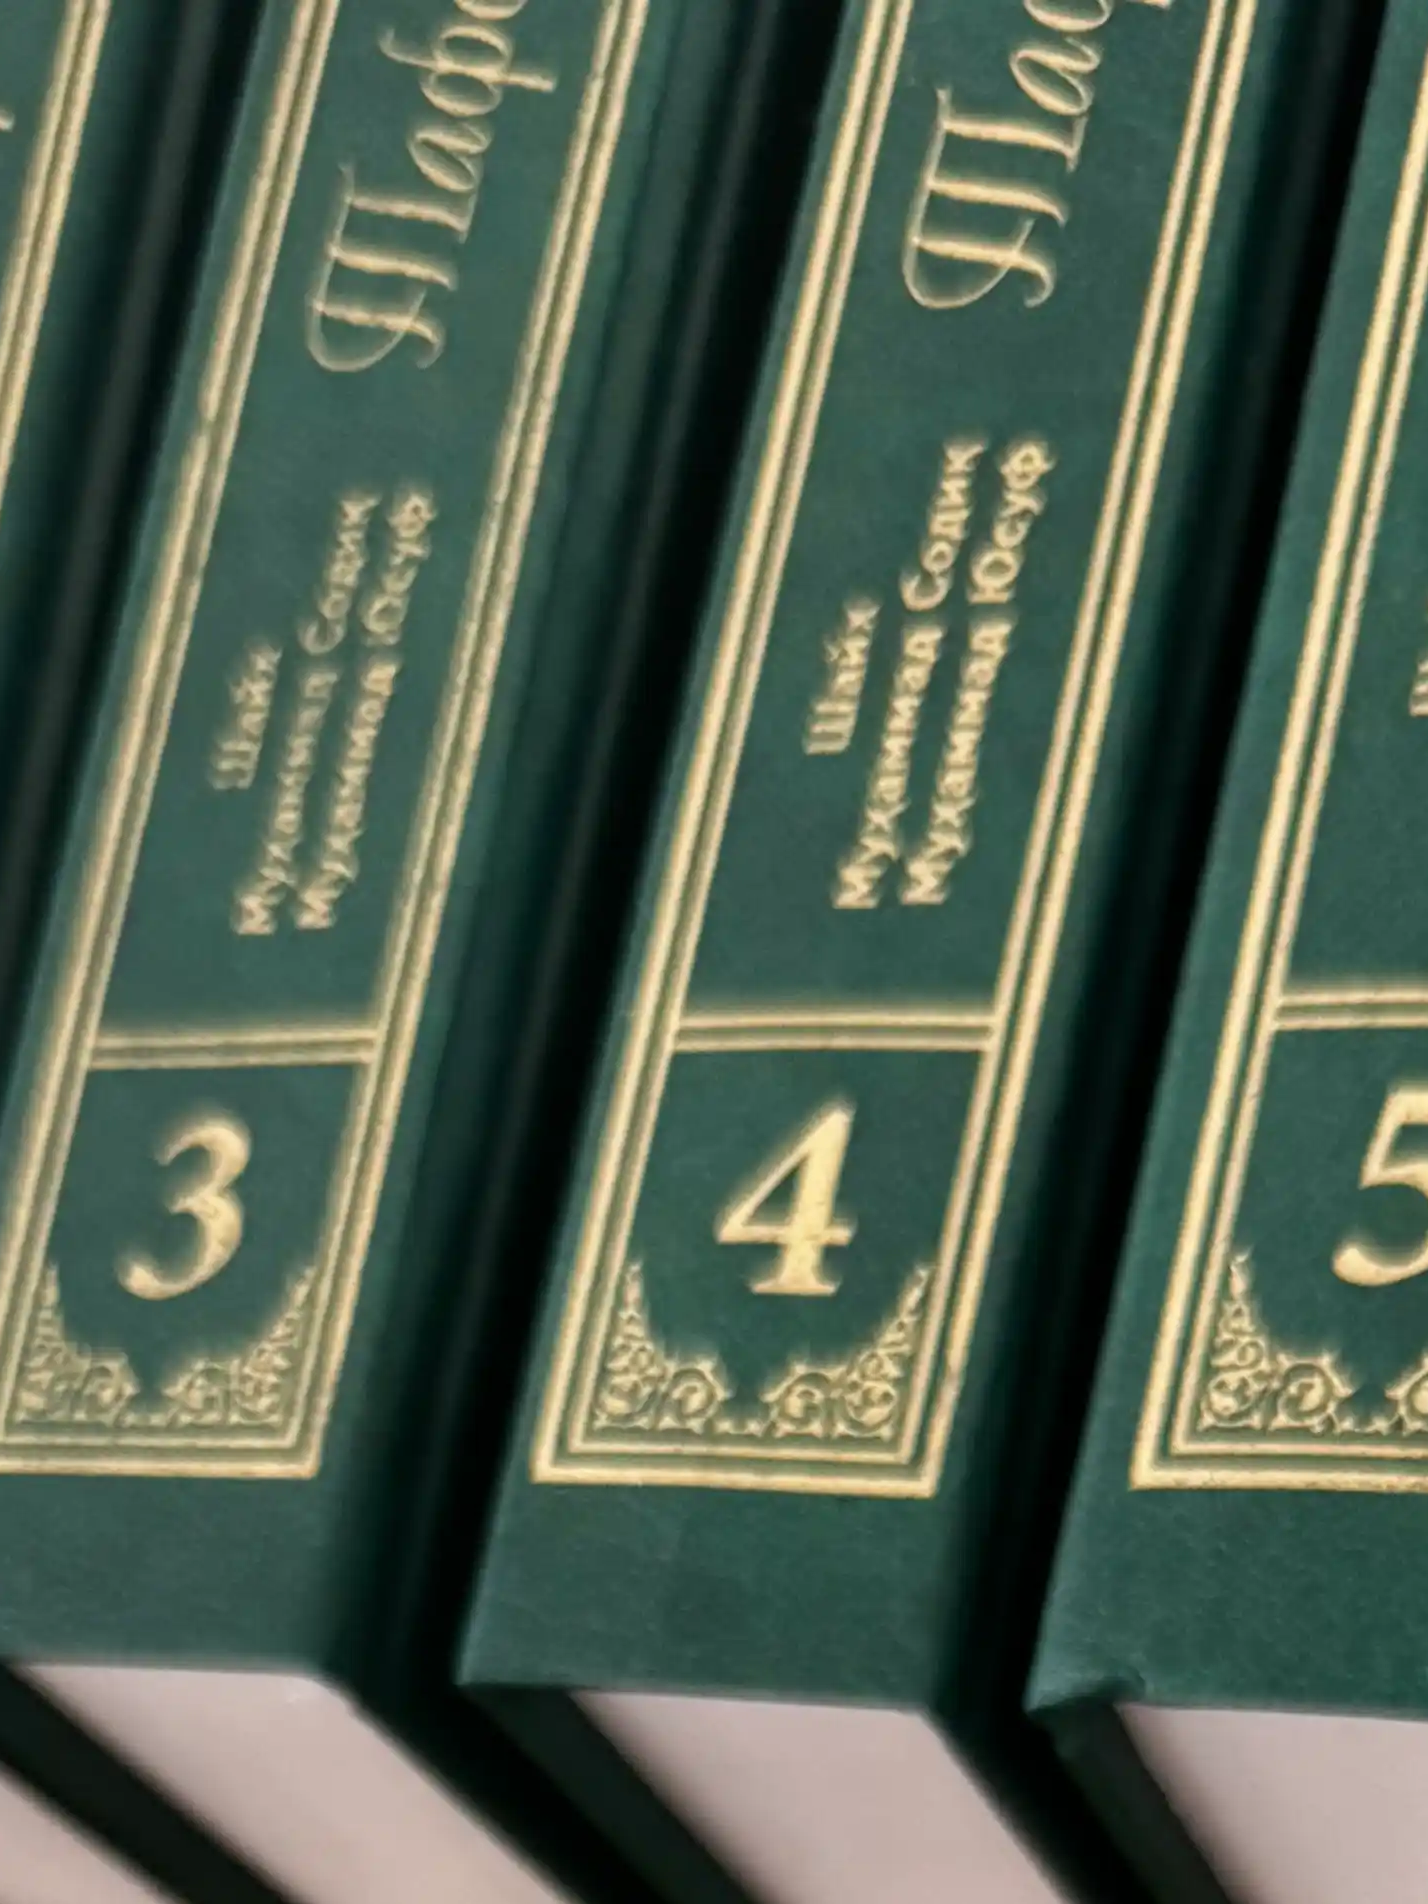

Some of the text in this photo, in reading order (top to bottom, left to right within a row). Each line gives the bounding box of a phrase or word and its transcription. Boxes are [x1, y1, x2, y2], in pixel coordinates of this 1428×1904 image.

[966, 438, 1057, 603] Юсуф
[802, 599, 880, 755] Шайх
[116, 1114, 250, 1300] 3
[715, 1100, 854, 1295] 4
